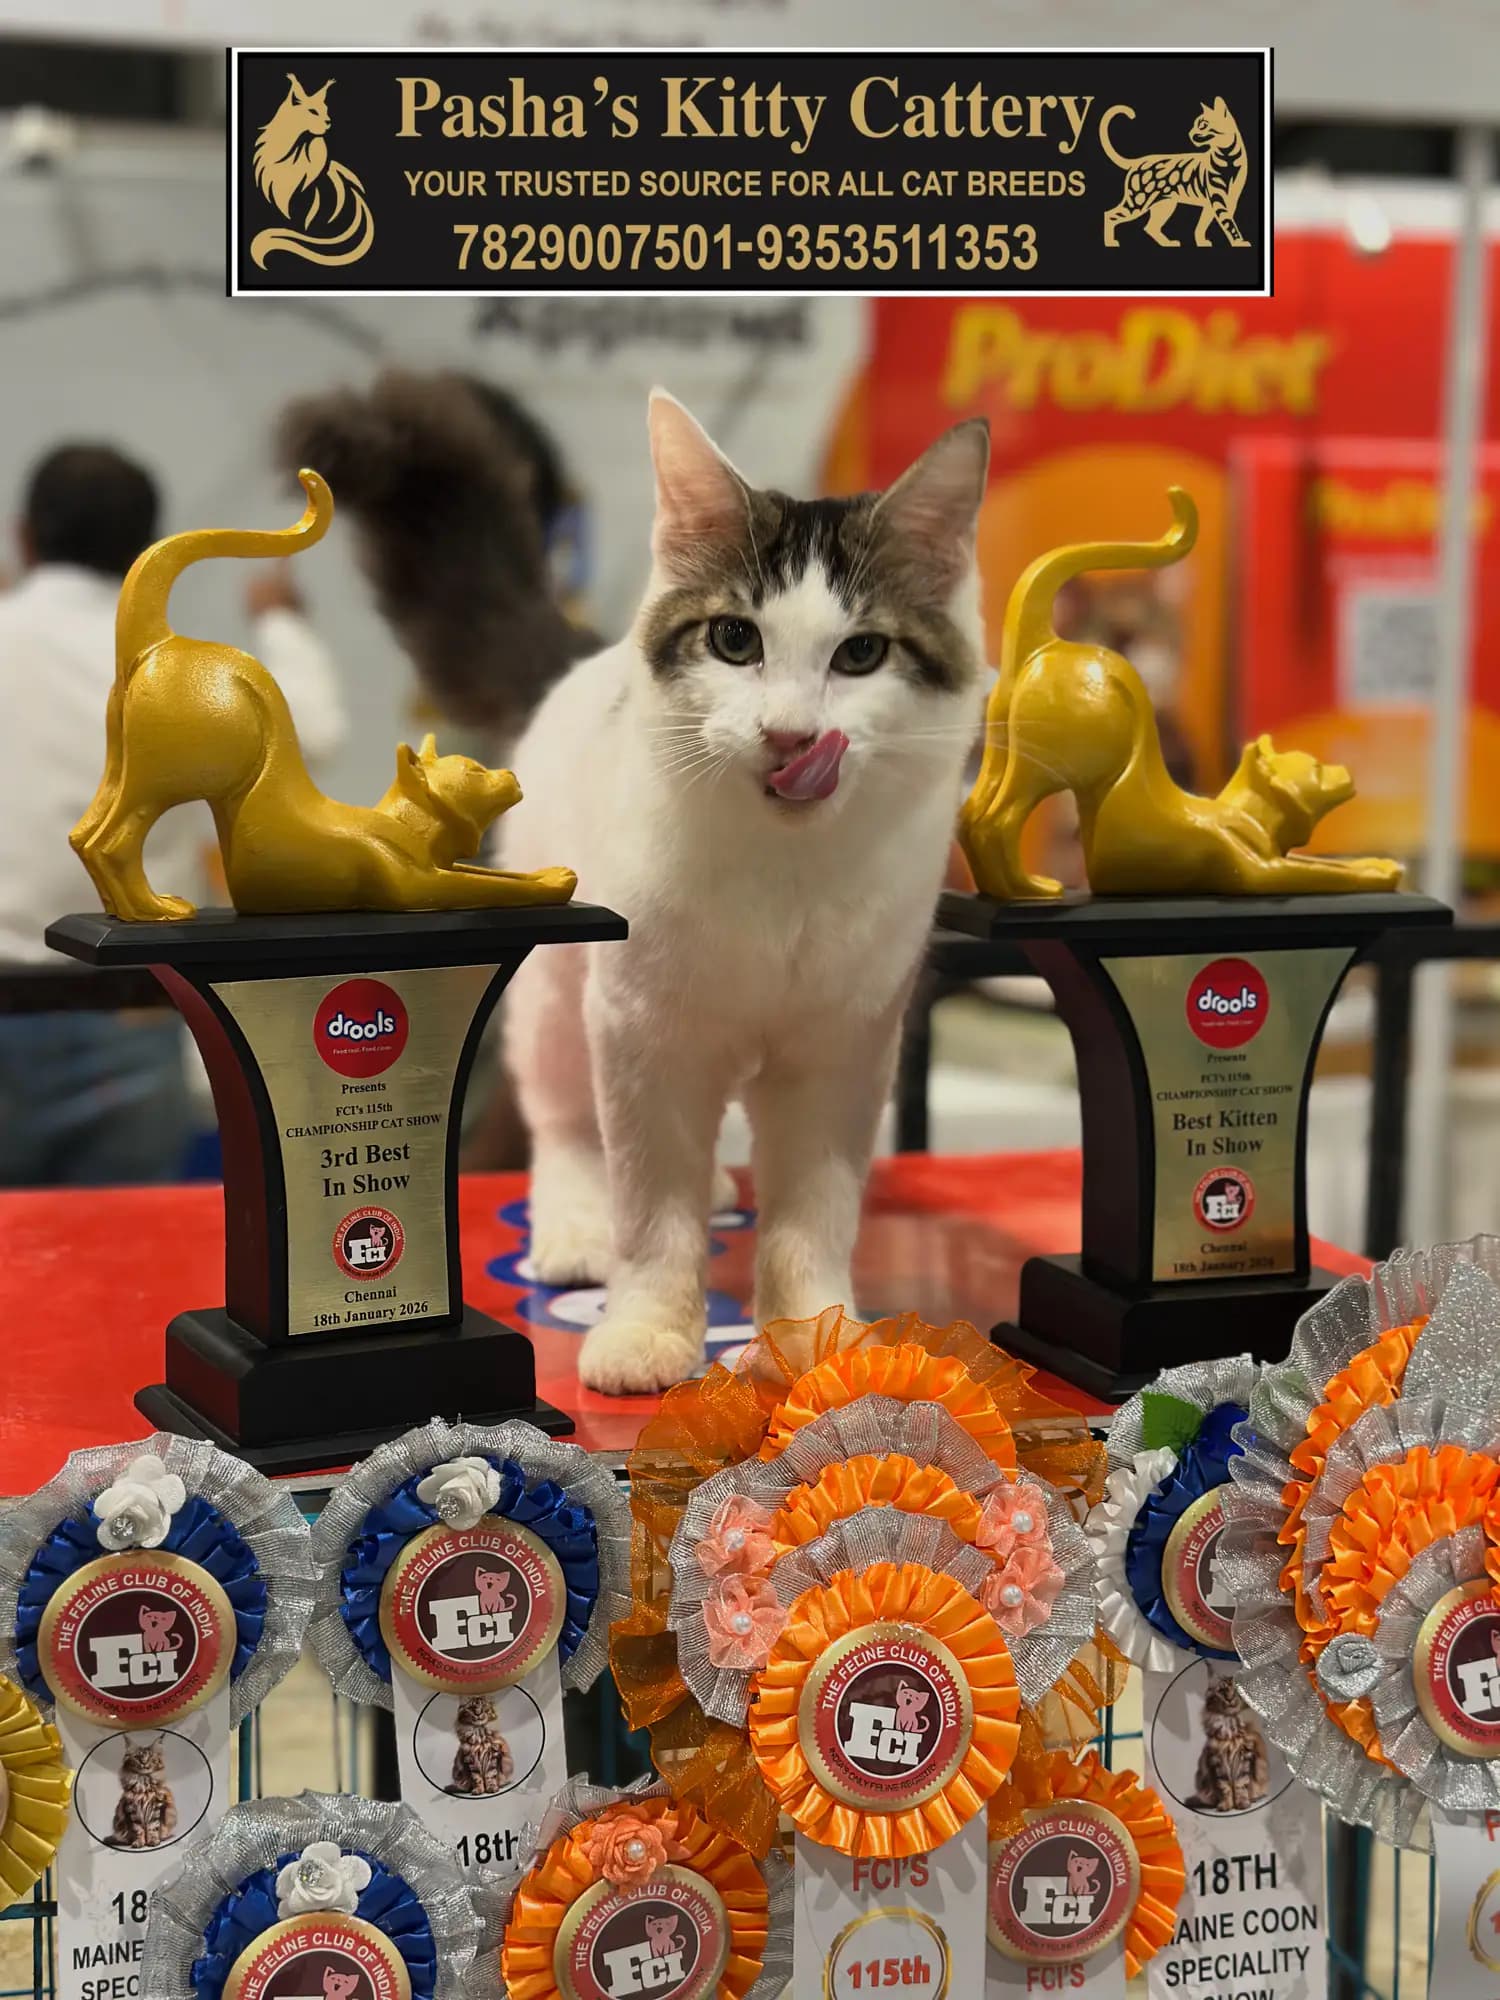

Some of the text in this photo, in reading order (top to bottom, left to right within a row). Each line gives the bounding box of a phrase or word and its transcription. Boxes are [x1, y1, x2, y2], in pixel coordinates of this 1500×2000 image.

[1198, 987, 1257, 1014] drools
[328, 1010, 395, 1040] drools
[341, 1082, 387, 1095] Presents
[335, 1102, 393, 1117] FCI's 115th
[1173, 1109, 1278, 1131] Best Kitten
[286, 1113, 443, 1138] CHAMPIONSHIP CAT SHOW
[320, 1142, 411, 1169] 3rd Best
[1187, 1136, 1264, 1157] In Show
[323, 1171, 411, 1198] In Show
[343, 1286, 398, 1304] Chennai
[313, 1301, 429, 1327] 18th January 2026
[1183, 1540, 1202, 1569] THE
[400, 1535, 546, 1616] THE FELINE CLUB OF INDIA
[58, 1573, 214, 1651] THE FELINE CLUB OF INDIA
[1438, 1606, 1474, 1650] FELINE
[1433, 1650, 1446, 1682] THE
[822, 1645, 957, 1729] THE FELINE CLUB OF INDIA
[456, 1829, 519, 1867] 18th
[996, 1820, 1127, 1887] THE FELINE CLUB OF INDIA
[853, 1855, 930, 1892] FCI'S
[1193, 1852, 1277, 1897] 18TH
[671, 1888, 691, 1902] OF
[582, 1896, 626, 1939] FELINE
[688, 1899, 712, 1935] INDIA
[1243, 1904, 1318, 1936] COON
[72, 1940, 145, 1970] MAINE
[243, 1976, 262, 2000] HE
[257, 1935, 308, 1976] FELINE
[312, 1932, 356, 1950] CLUB
[356, 1945, 377, 1963] OF
[575, 1942, 590, 1971] THE
[1165, 1945, 1310, 1987] SPECIALITY
[846, 1954, 931, 1990] 115th
[1026, 1963, 1086, 1993] FCI'S
